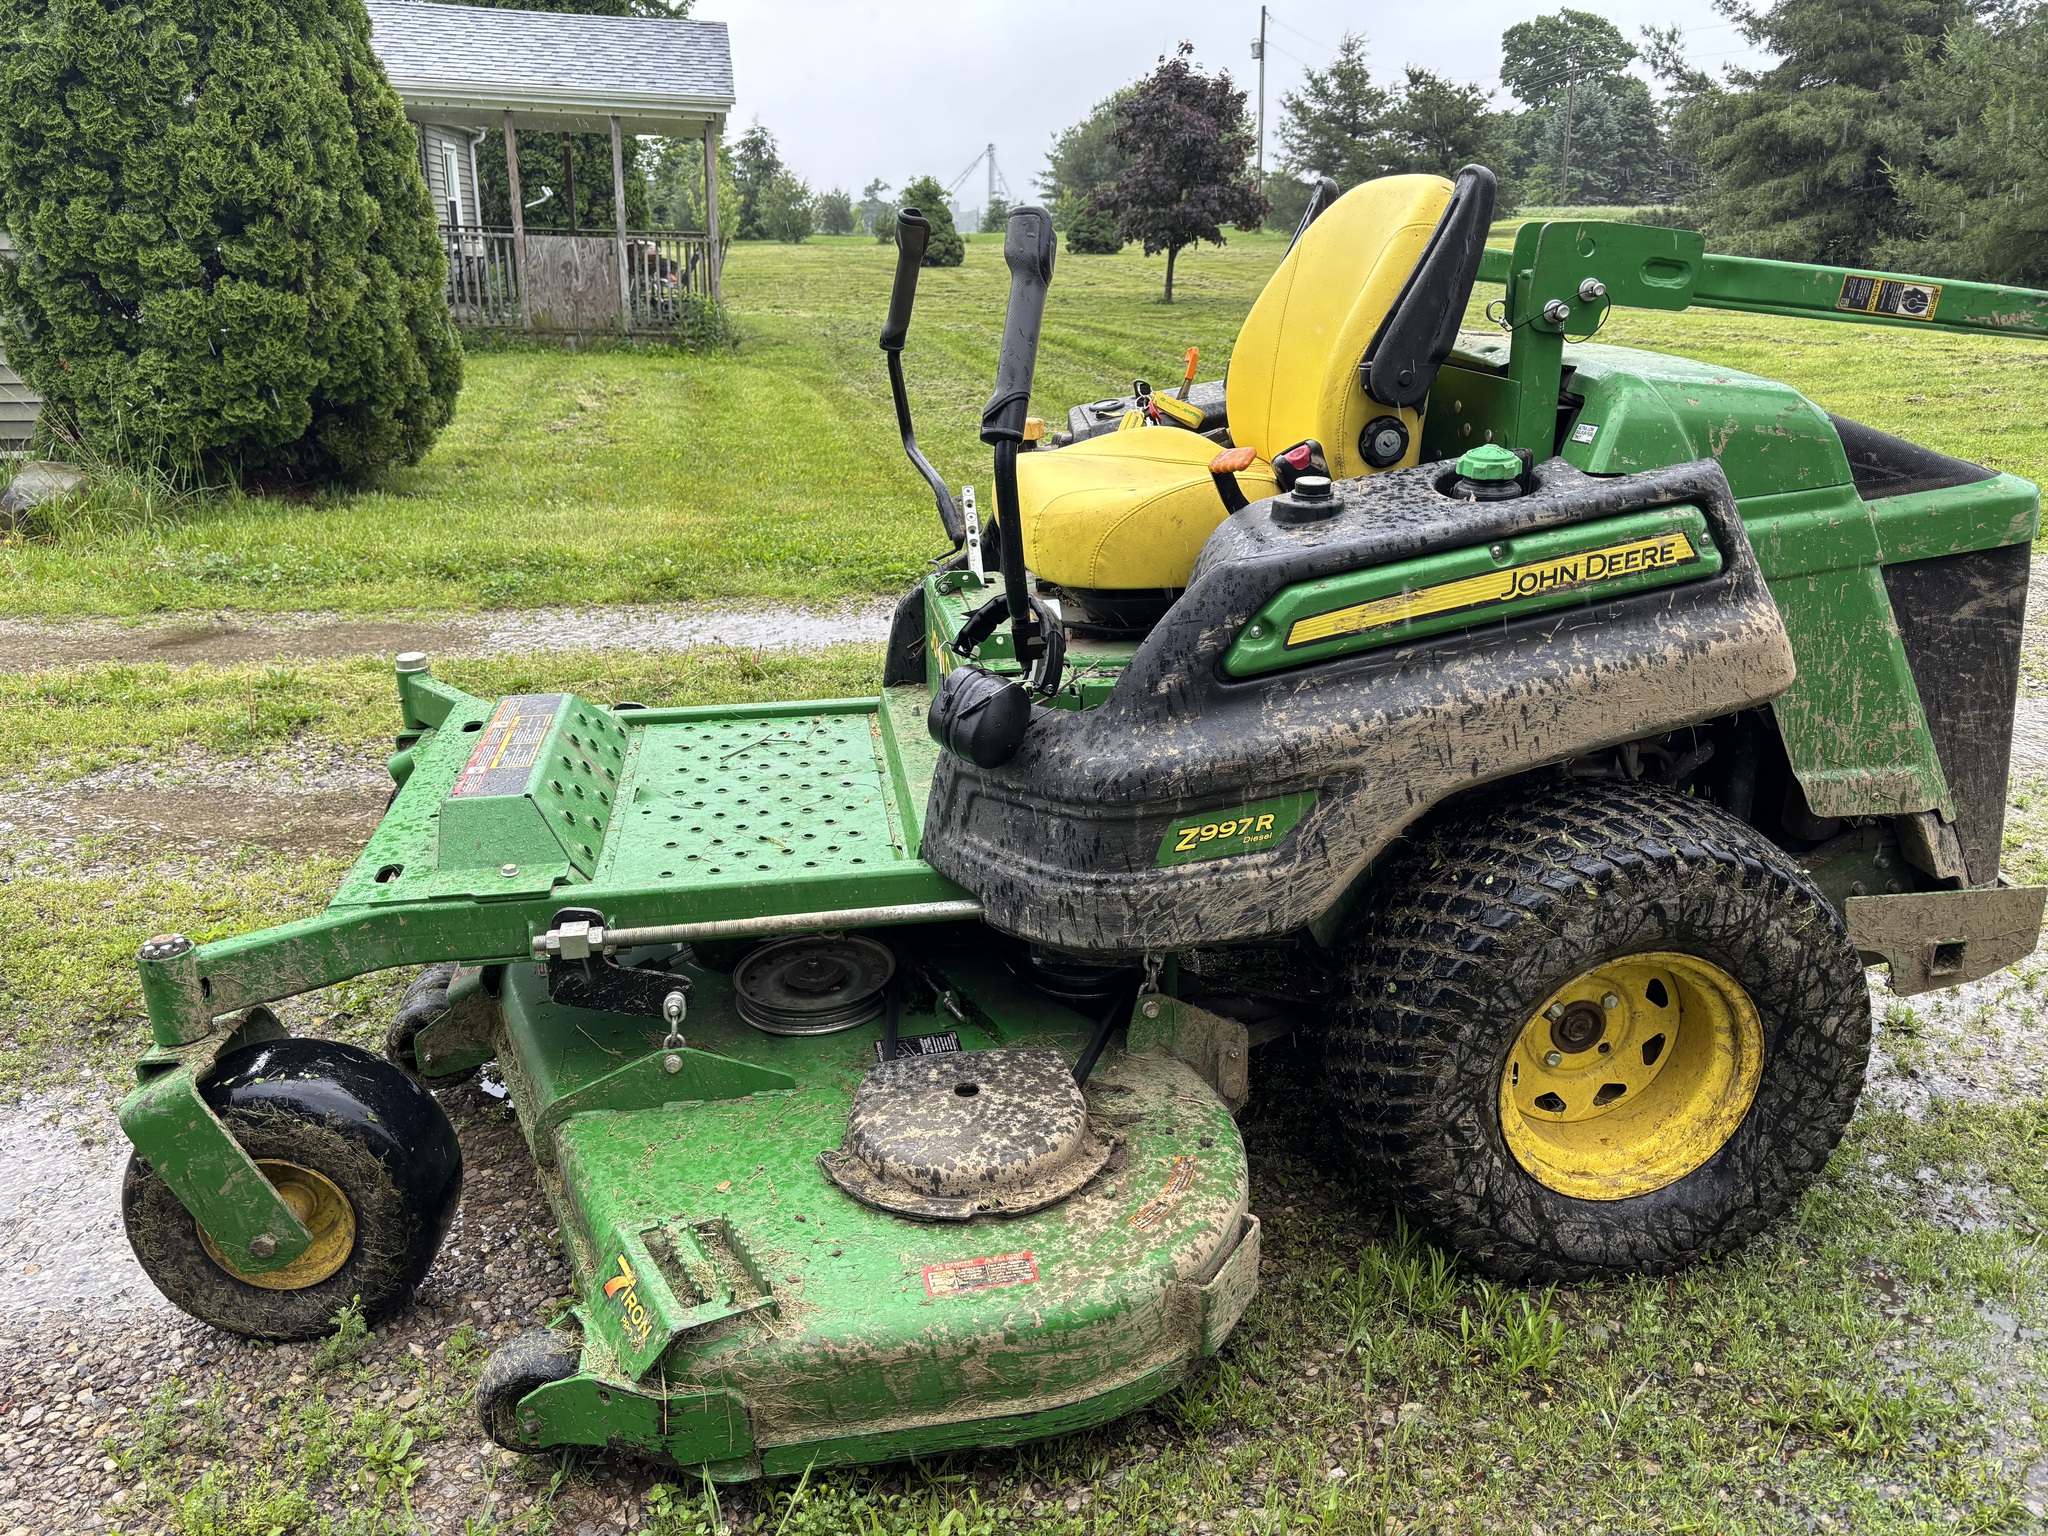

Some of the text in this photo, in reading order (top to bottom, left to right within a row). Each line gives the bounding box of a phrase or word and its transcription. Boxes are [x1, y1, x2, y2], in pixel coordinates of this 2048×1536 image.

[1501, 543, 1675, 598] JOHN DEERE
[1174, 813, 1276, 852] Z997R
[1243, 832, 1273, 844] Diesel
